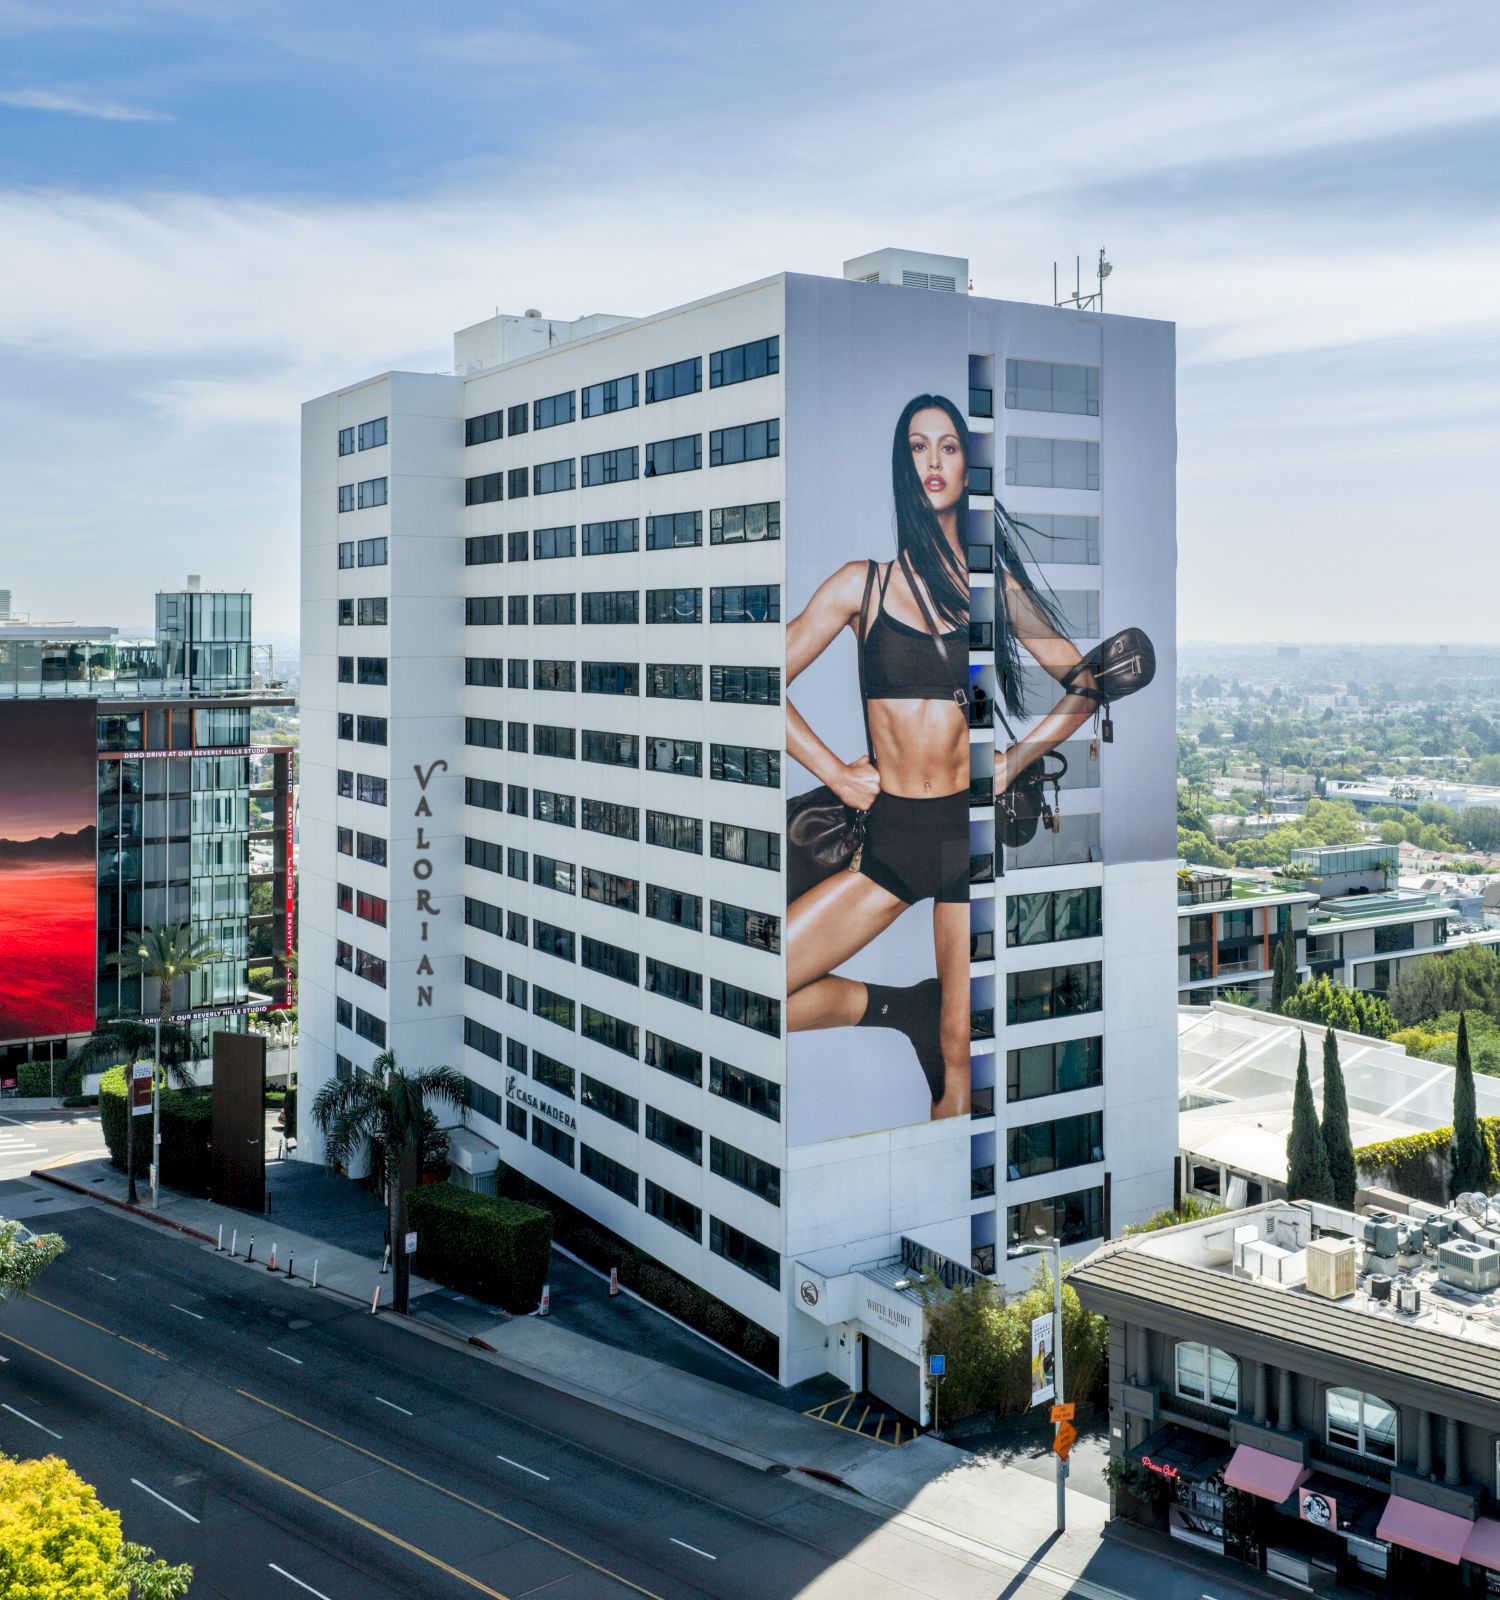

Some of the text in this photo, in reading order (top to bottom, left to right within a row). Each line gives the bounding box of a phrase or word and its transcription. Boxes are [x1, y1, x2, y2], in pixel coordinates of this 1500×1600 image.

[413, 759, 448, 1007] VALORIAN
[193, 1011, 221, 1019] BEVERLY
[222, 1008, 241, 1016] HILLS
[242, 1006, 268, 1014] STUDIO
[516, 1089, 577, 1130] CASA MADERA
[866, 1298, 887, 1317] WHITE
[888, 1307, 912, 1328] RABBIT
